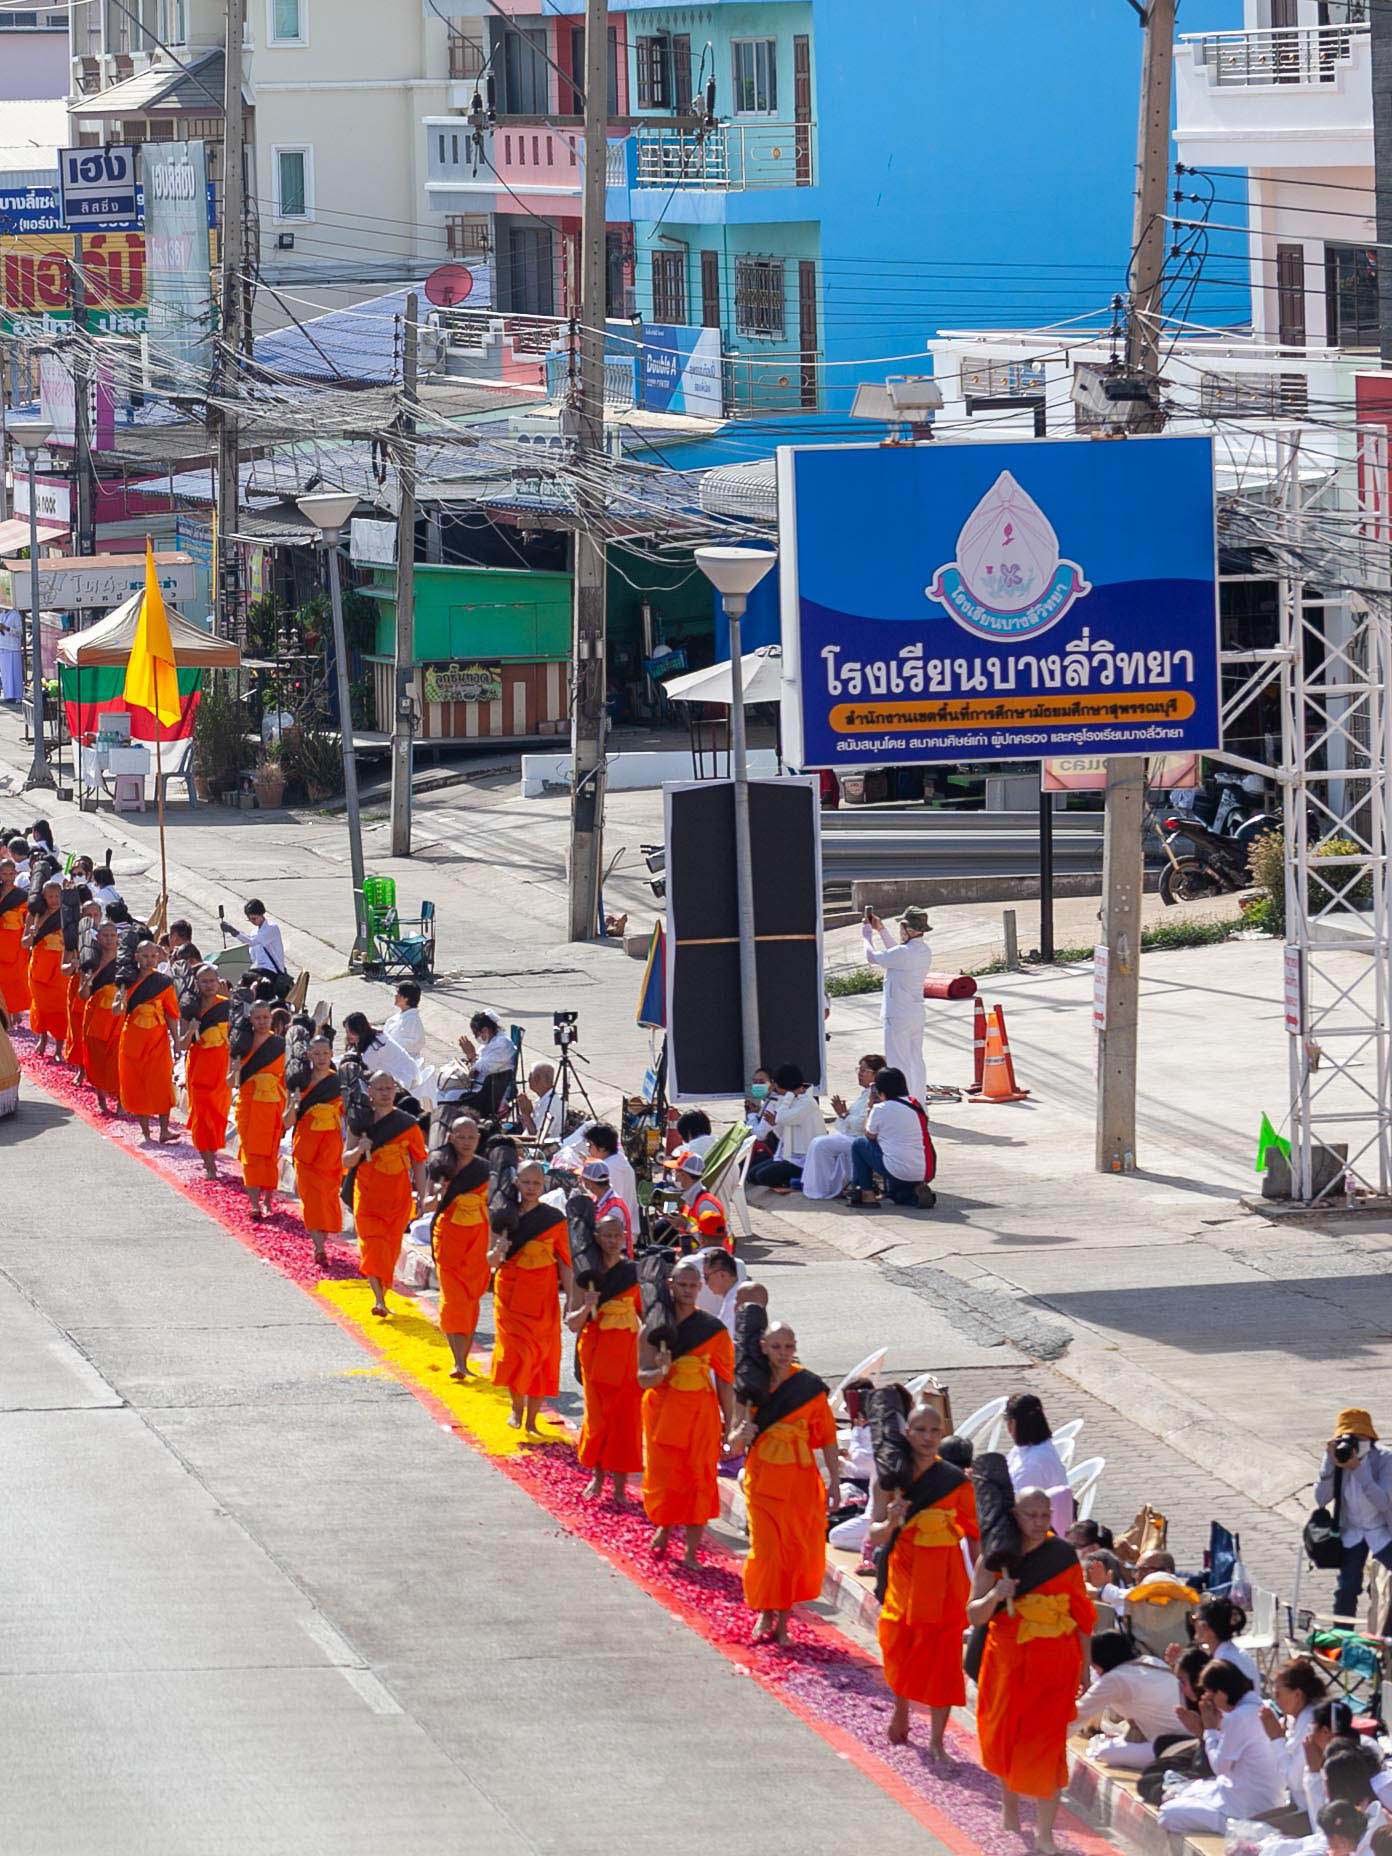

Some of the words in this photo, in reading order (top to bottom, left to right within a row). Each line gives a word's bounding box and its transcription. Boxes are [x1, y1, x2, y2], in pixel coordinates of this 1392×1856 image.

[68, 154, 127, 184] เฮง
[646, 353, 670, 375] Double
[820, 627, 1194, 697] โรงเรียนบางลี่วิทยา
[845, 698, 1178, 725] สำนักงานเขตพื้นที่การศึกษามัธยมศึกษาสุพรรณบุรี
[836, 736, 906, 752] สนับสนุนโดย
[909, 732, 988, 750] สมาคมศิษย์เก่า
[991, 731, 1048, 748] ผู้ปกครอง
[1050, 725, 1185, 746] และครูโรงเรียนบางลี่วิทยา
